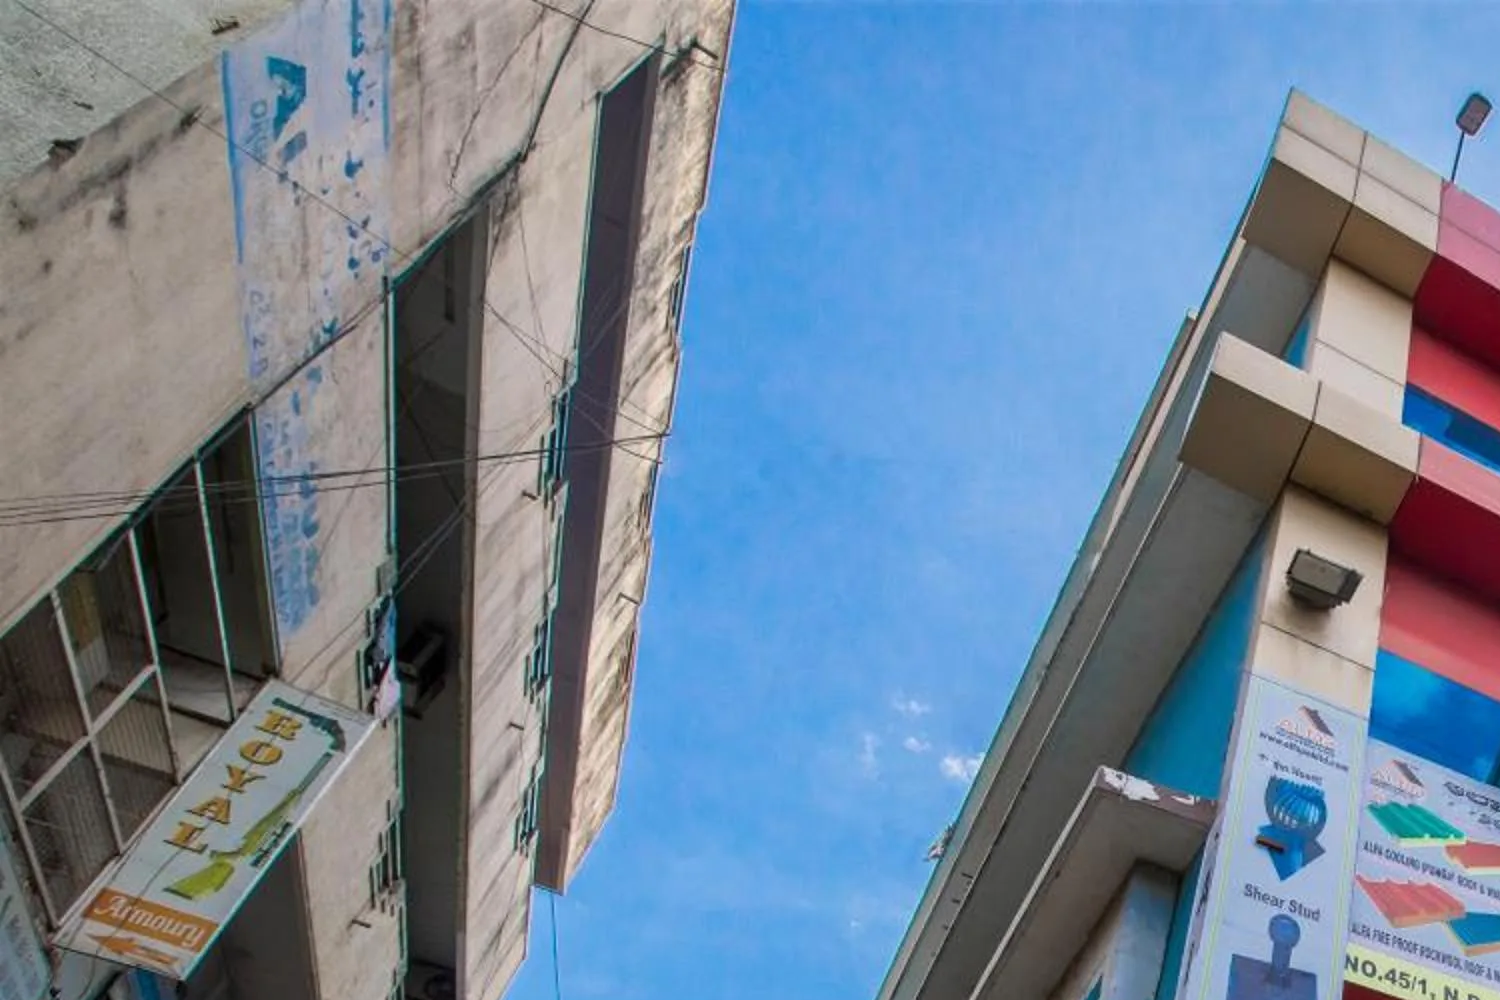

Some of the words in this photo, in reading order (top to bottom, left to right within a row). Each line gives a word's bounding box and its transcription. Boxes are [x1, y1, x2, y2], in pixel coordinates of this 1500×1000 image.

[164, 708, 303, 855] ROYAL
[94, 894, 206, 947] Armoury
[1243, 882, 1285, 912] Shear
[1288, 899, 1321, 919] Stud
